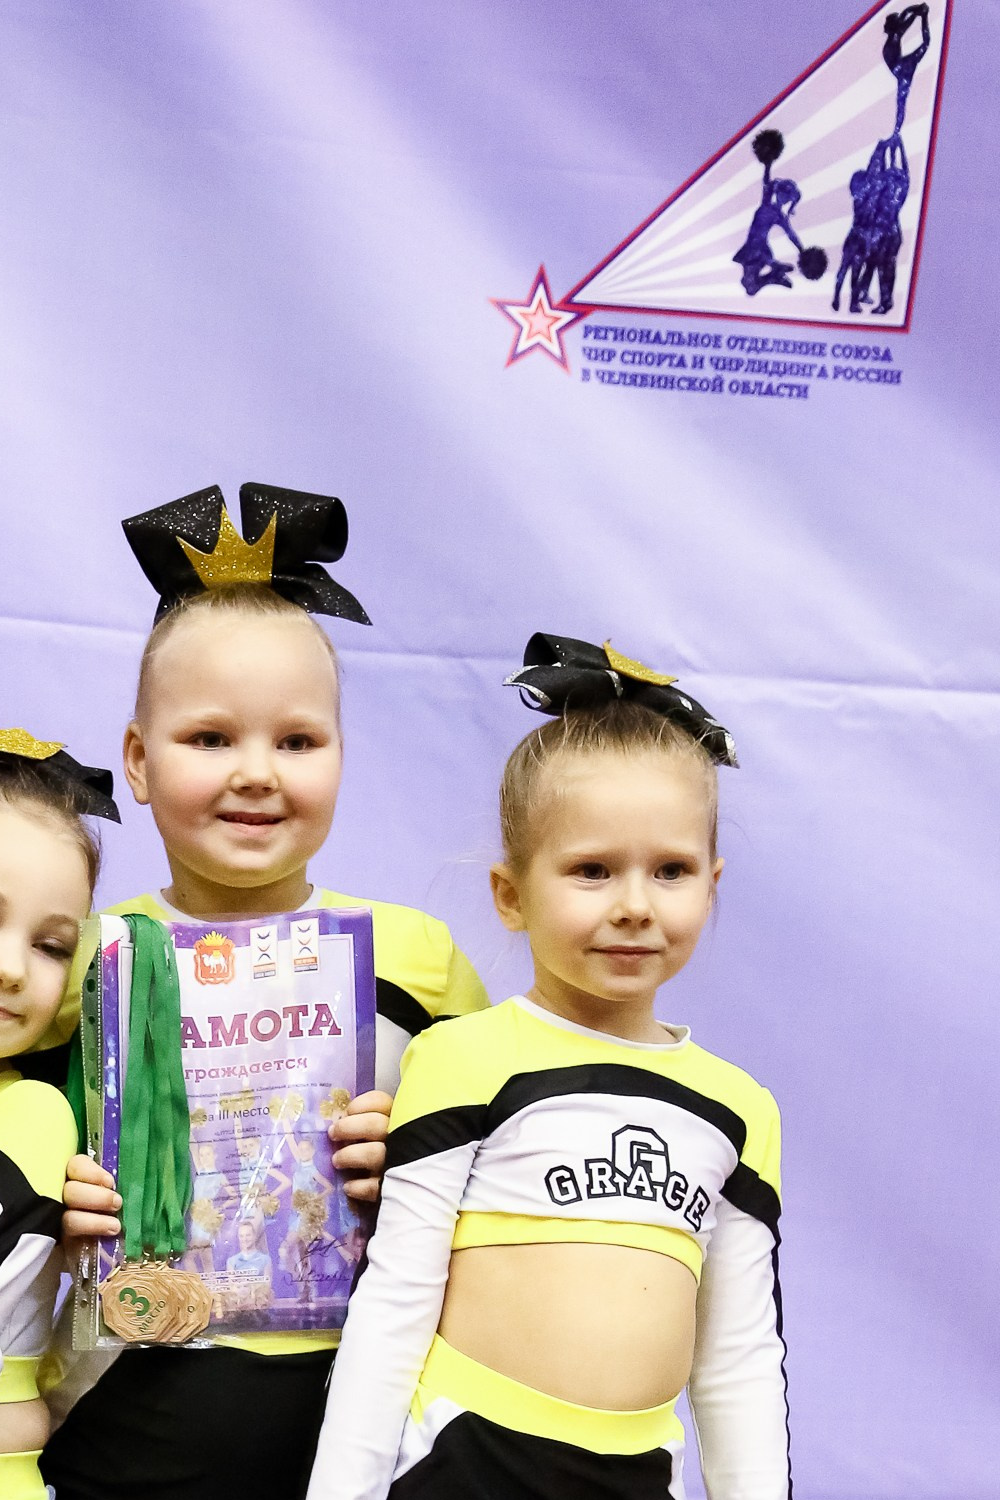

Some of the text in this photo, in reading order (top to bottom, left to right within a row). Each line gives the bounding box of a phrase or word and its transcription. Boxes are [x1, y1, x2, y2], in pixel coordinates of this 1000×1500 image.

[583, 325, 893, 363] РЕГИОНАЛЬНОЕ ОТДЕЛЕНИЕ СОЮЗА
[582, 346, 903, 385] ЧИР СПОРТА И ЧИРЛИДИНГА РОССИИ
[581, 368, 809, 399] В ЧЕЛЯБИНСКОЙ ОБЛАСТИ
[181, 1003, 342, 1049] АМОТА
[184, 1057, 308, 1083] граждается
[233, 1106, 270, 1119] место
[544, 1157, 711, 1233] GRACE
[119, 1287, 150, 1317] 3
